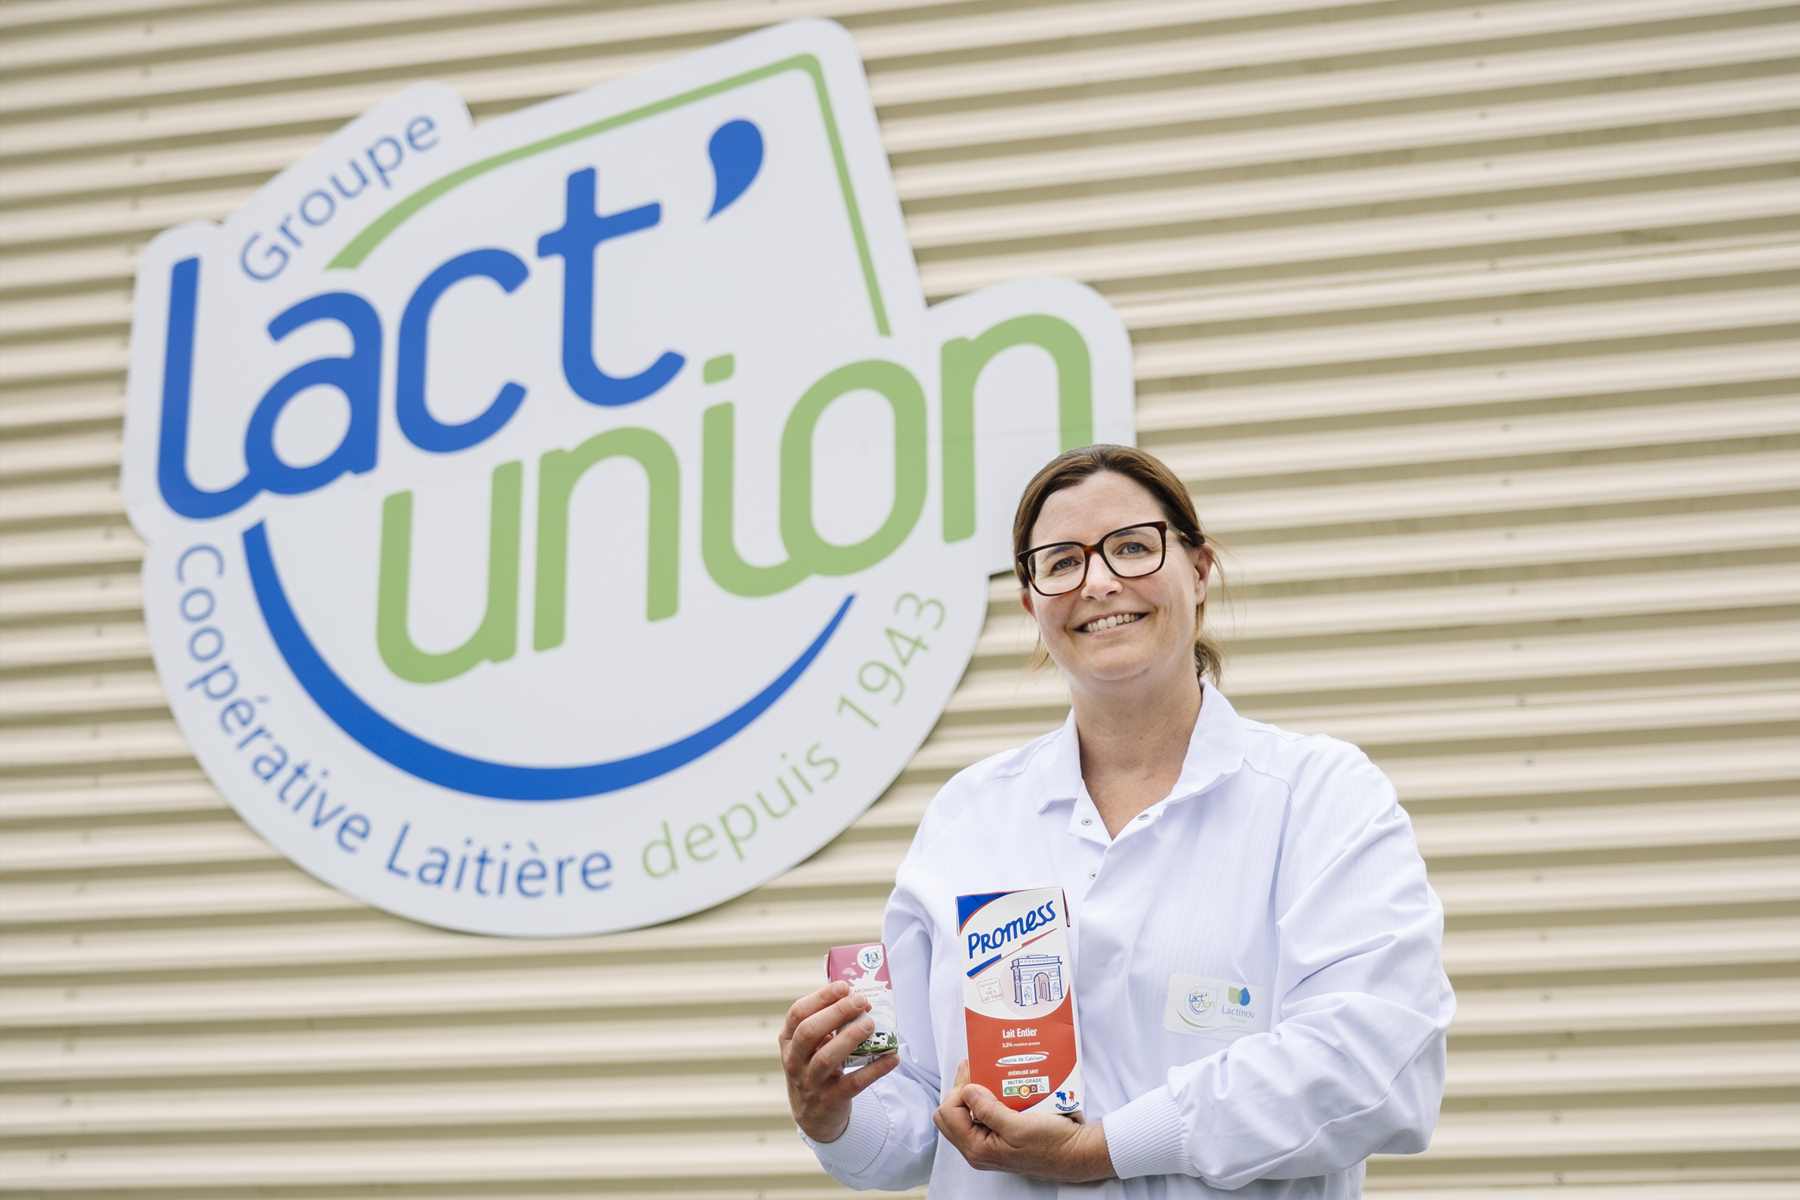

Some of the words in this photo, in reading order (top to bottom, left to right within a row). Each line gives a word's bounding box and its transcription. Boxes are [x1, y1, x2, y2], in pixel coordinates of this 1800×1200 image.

[240, 115, 440, 283] Groupe
[376, 313, 1093, 684] union
[177, 543, 372, 854] Coopérative
[385, 822, 614, 899] Laitière
[641, 741, 841, 880] depuis
[837, 592, 946, 730] 1943
[1002, 1029, 1015, 1039] Lait
